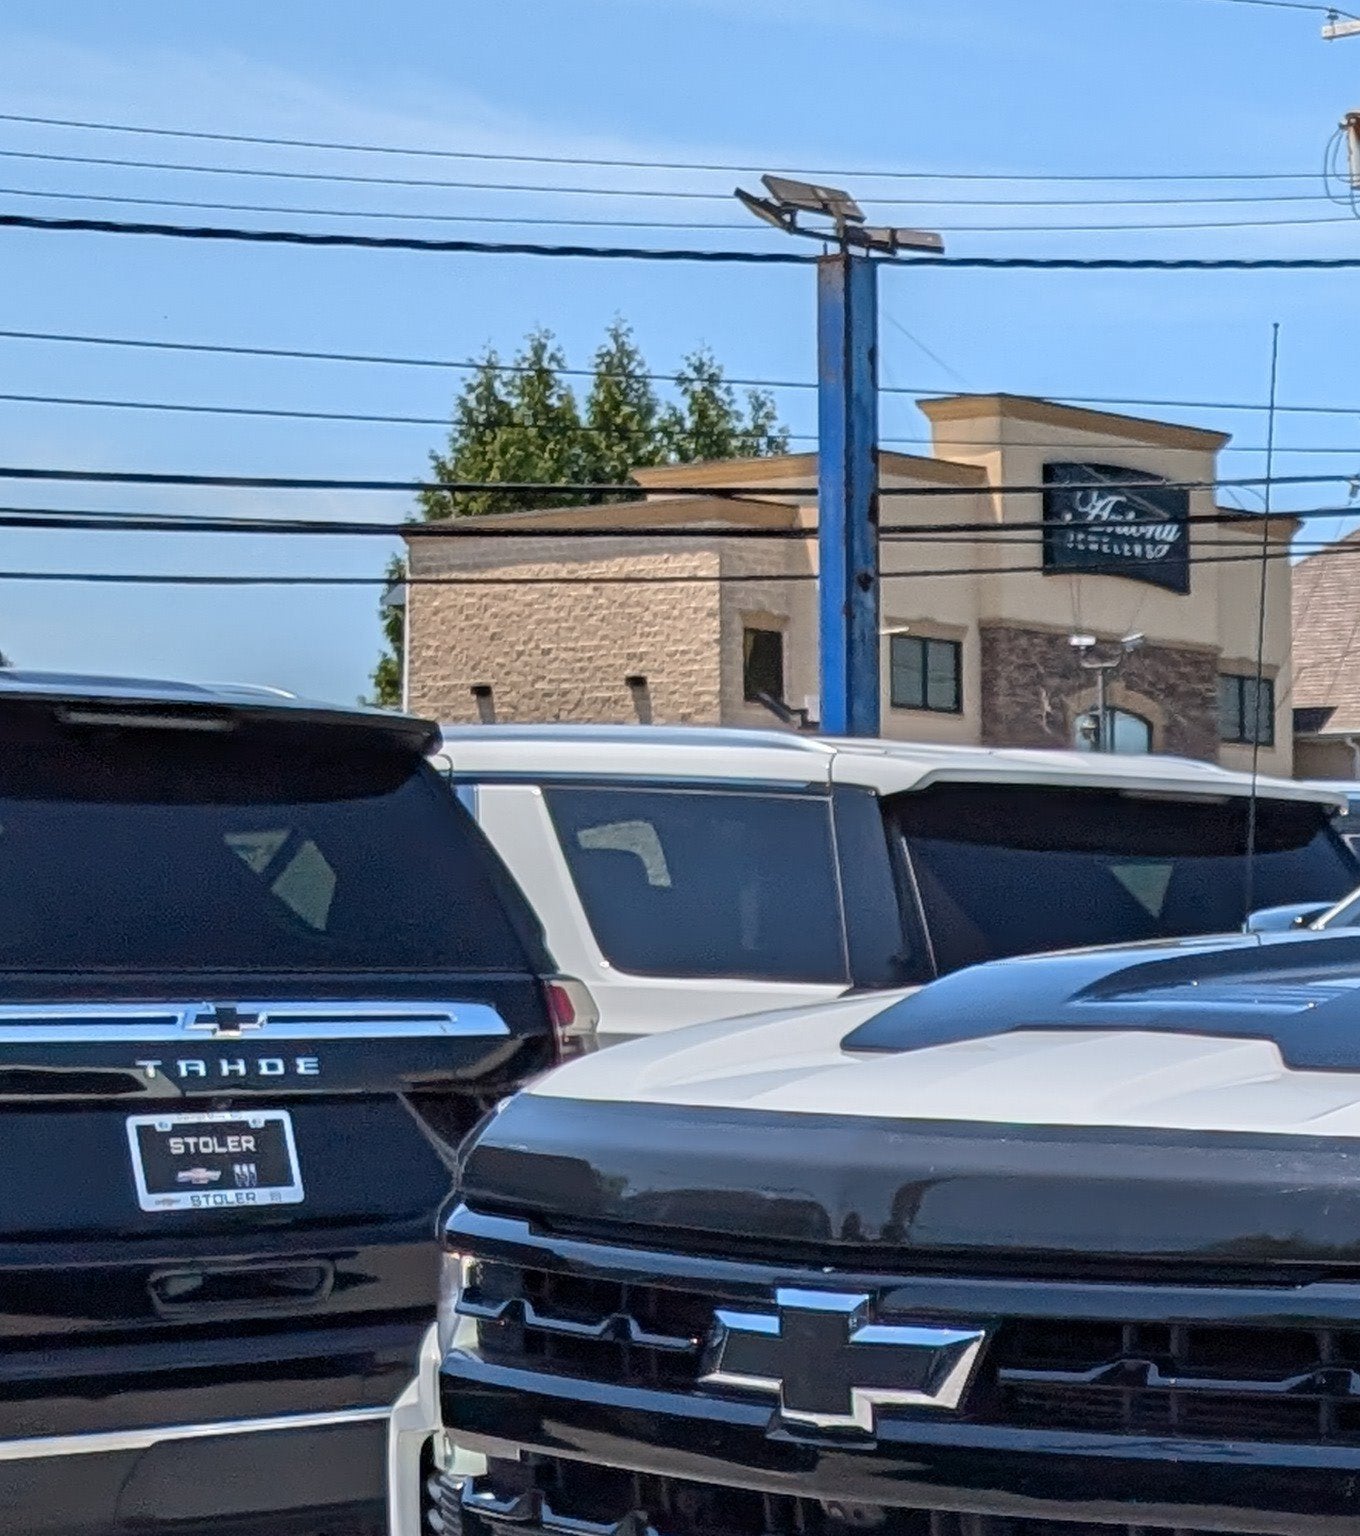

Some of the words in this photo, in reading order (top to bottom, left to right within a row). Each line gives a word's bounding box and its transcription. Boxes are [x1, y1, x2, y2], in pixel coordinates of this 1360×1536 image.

[135, 1056, 320, 1078] TAHOE
[169, 1135, 257, 1155] STOLER
[190, 1192, 257, 1208] STOLER
